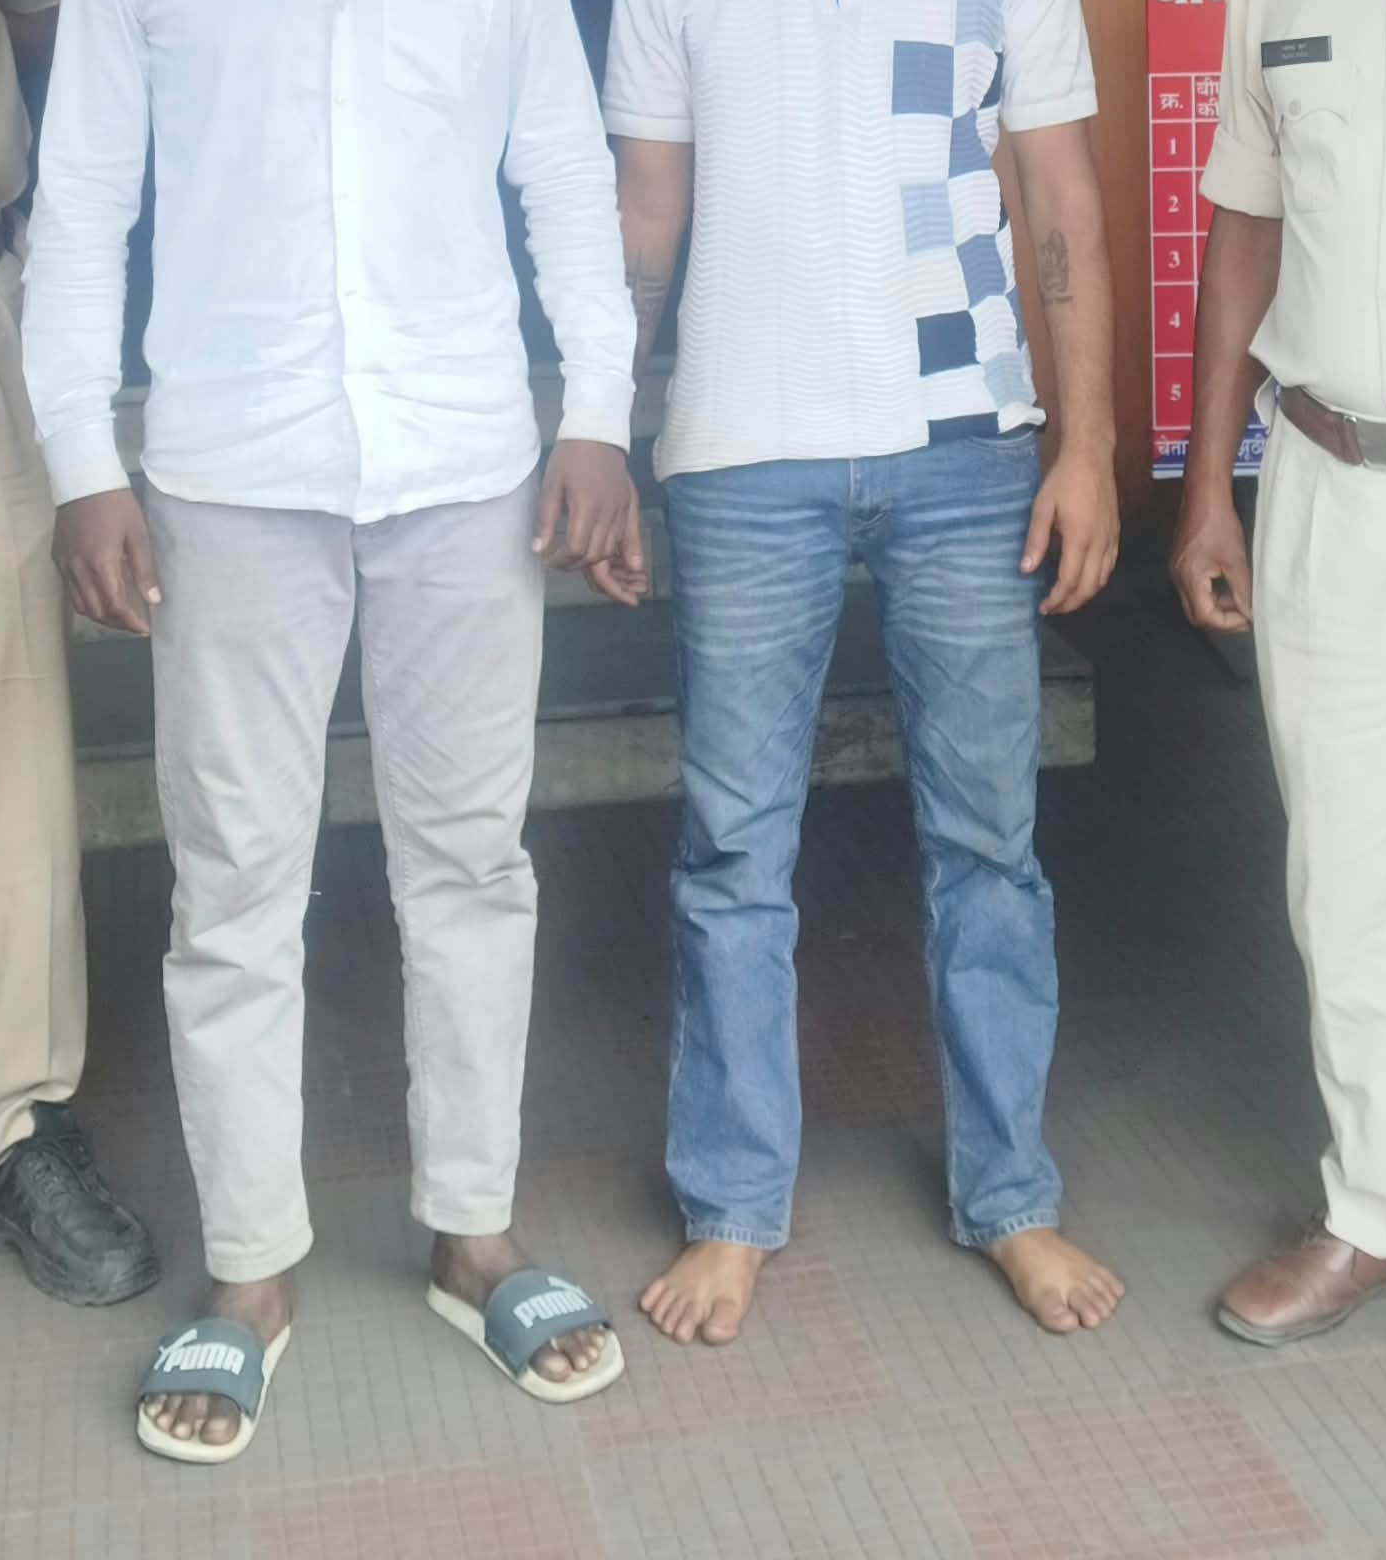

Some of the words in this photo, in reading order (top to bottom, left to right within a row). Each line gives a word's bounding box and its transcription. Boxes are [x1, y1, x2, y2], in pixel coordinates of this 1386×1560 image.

[1167, 138, 1179, 156] 1
[1168, 195, 1181, 214] 2
[1168, 251, 1181, 269] 3
[1168, 310, 1181, 329] 4
[1169, 383, 1182, 402] 5
